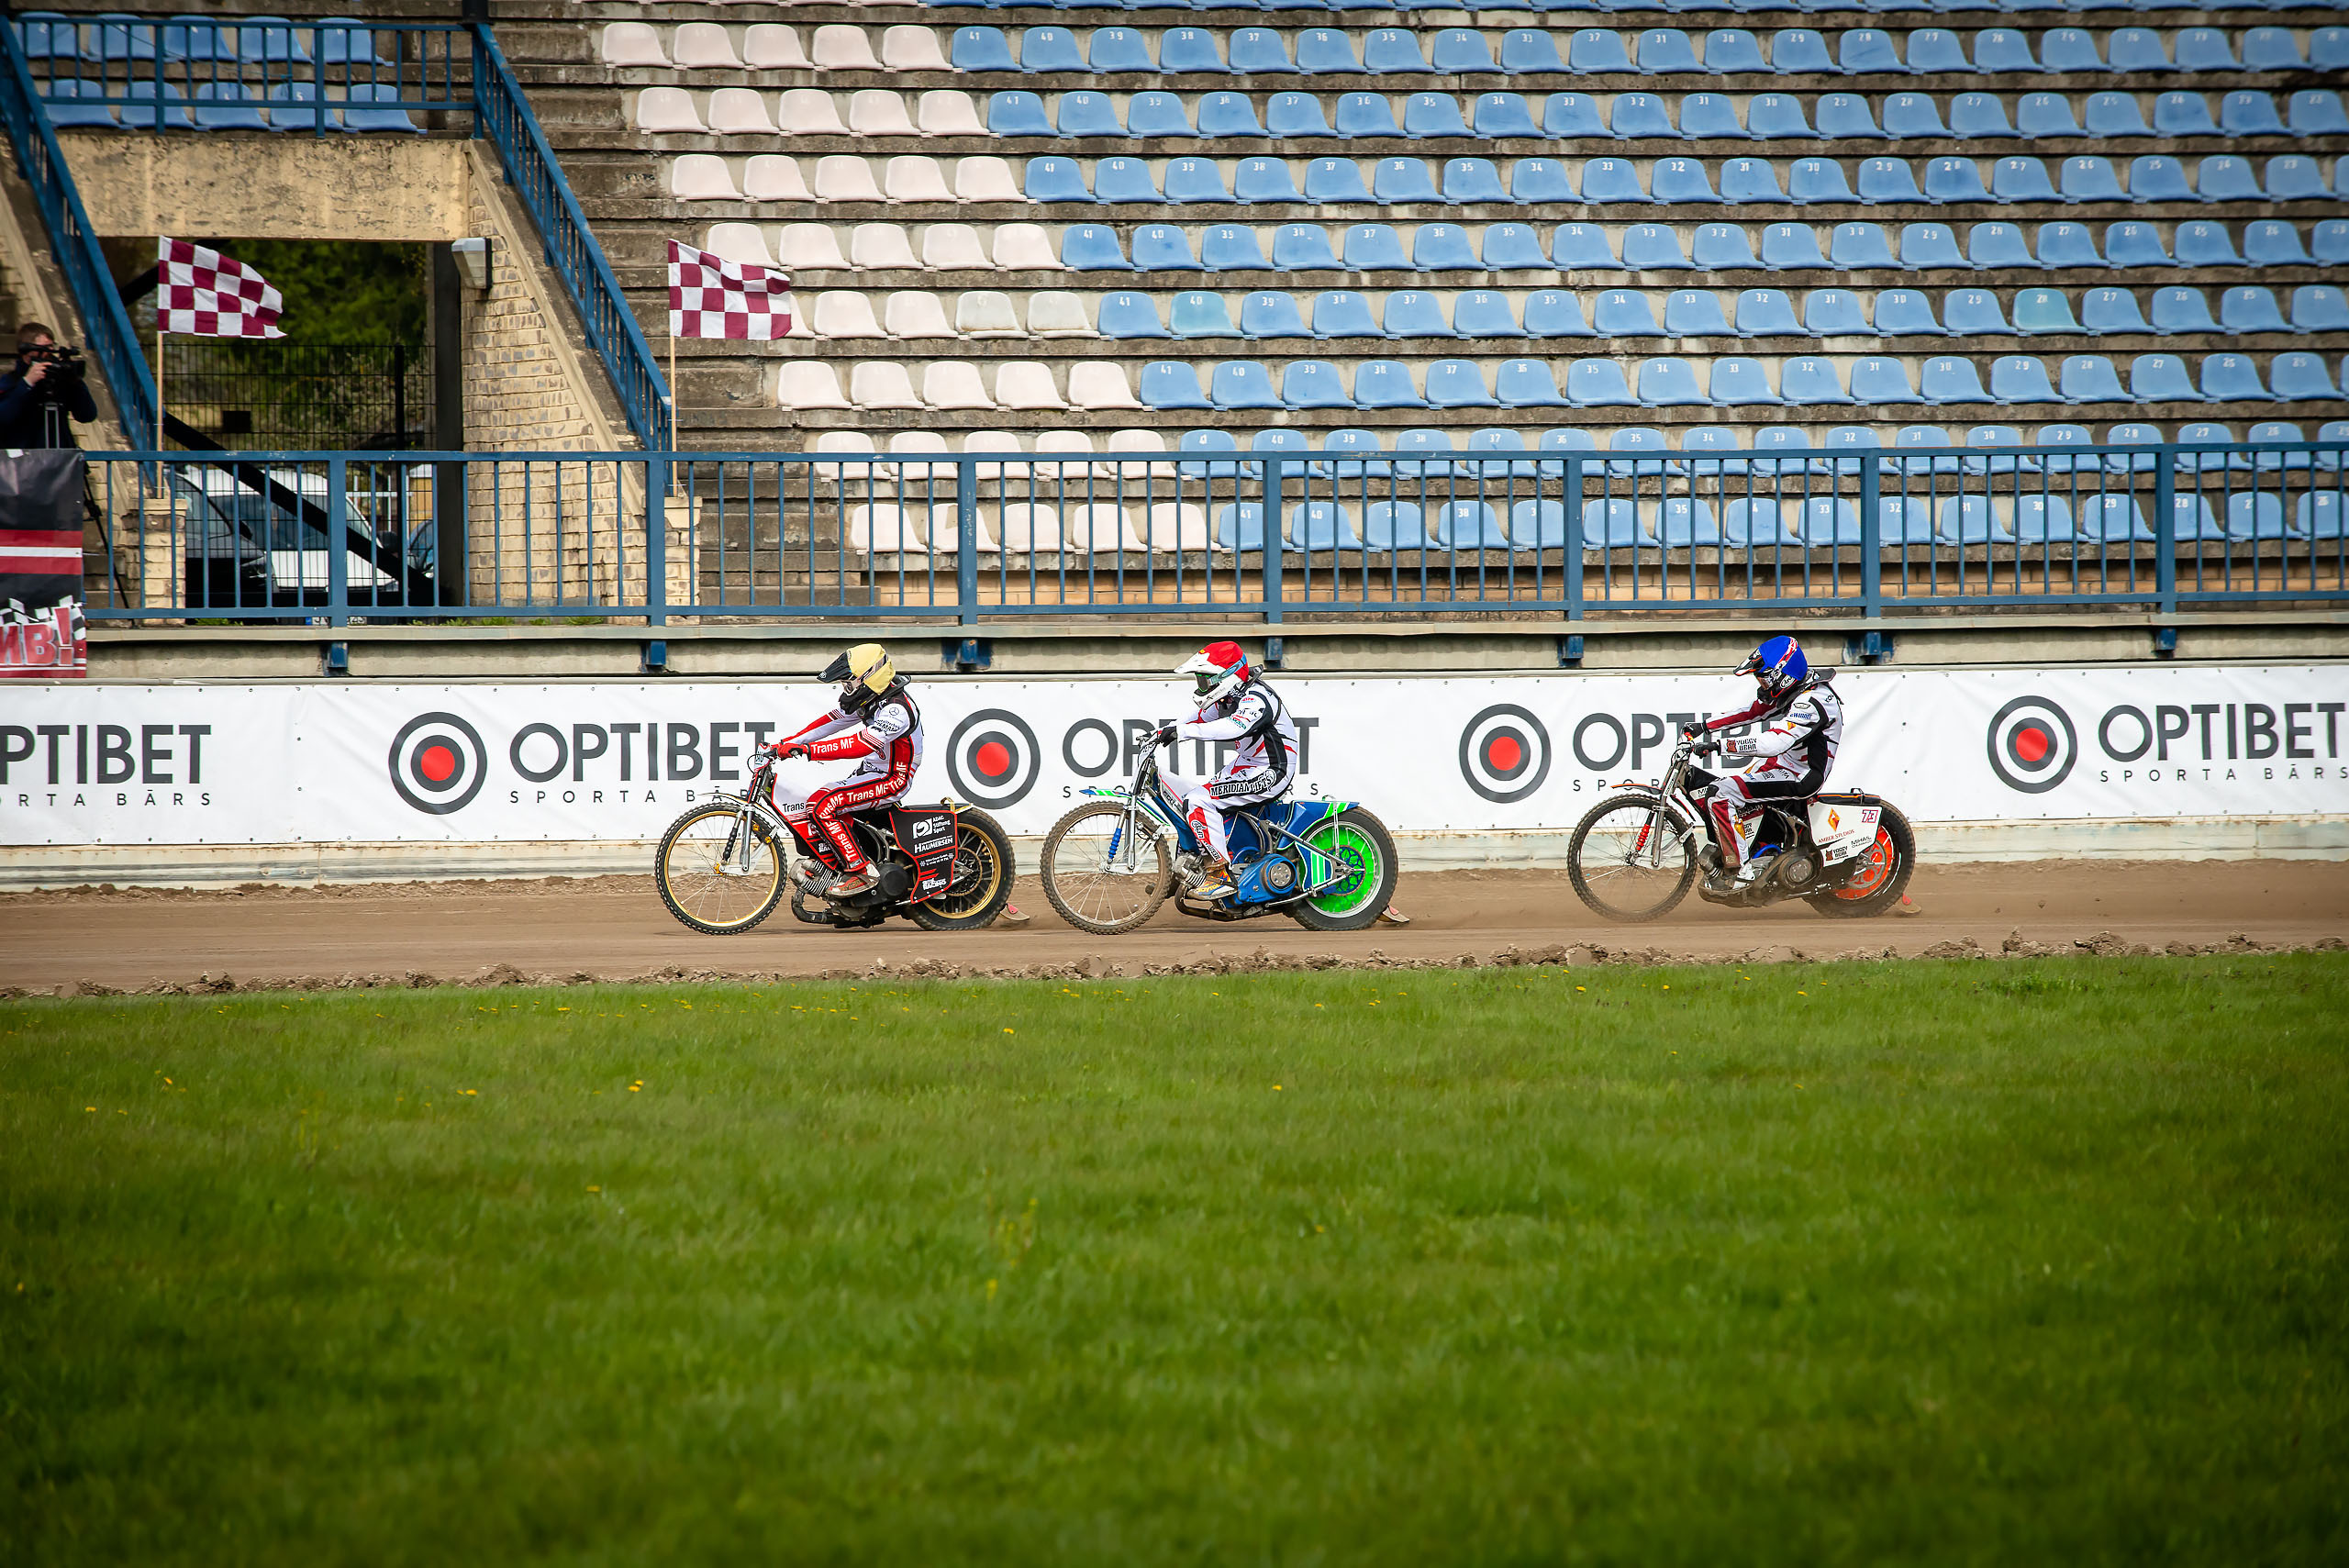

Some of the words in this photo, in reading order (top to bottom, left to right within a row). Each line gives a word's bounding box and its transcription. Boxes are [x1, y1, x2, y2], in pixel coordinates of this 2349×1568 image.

[968, 30, 981, 41] 41
[1040, 31, 1054, 42] 40
[1108, 30, 1124, 41] 39
[1180, 30, 1195, 41] 38
[1247, 32, 1261, 42] 37
[1315, 31, 1329, 42] 36
[1381, 31, 1397, 42] 35
[1454, 32, 1468, 42] 34
[1521, 33, 1532, 43] 33
[1654, 33, 1667, 44] 31
[1721, 33, 1735, 44] 30
[1790, 32, 1805, 43] 29
[1006, 95, 1019, 106] 41
[1075, 95, 1090, 106] 40
[1286, 95, 1299, 106] 37
[1356, 95, 1372, 106] 36
[1424, 96, 1436, 106] 35
[1491, 95, 1506, 106] 34
[1563, 96, 1575, 106] 33
[1631, 95, 1644, 106] 32
[1698, 95, 1709, 106] 31
[1765, 96, 1778, 107] 30
[1044, 162, 1054, 172] 41
[1111, 160, 1126, 171] 40
[1181, 161, 1196, 172] 39
[1253, 160, 1265, 171] 38
[1325, 160, 1336, 171] 37
[1394, 161, 1406, 171] 36
[1461, 161, 1474, 172] 35
[1531, 161, 1542, 172] 34
[1601, 161, 1616, 172] 33
[1671, 161, 1685, 172] 32
[1739, 161, 1751, 172] 31
[1807, 161, 1820, 172] 30
[1877, 161, 1892, 172] 29
[1943, 161, 1960, 171] 28
[2009, 161, 2026, 171] 27
[1083, 228, 1094, 239] 41
[1151, 228, 1164, 239] 40
[1292, 227, 1306, 238] 38
[1364, 228, 1375, 239] 37
[1432, 227, 1446, 238] 36
[1502, 226, 1516, 237] 35
[1570, 226, 1584, 236] 34
[1711, 227, 1728, 238] 32
[1780, 227, 1791, 238] 31
[1849, 226, 1864, 236] 30
[1923, 229, 1937, 239] 29
[2057, 225, 2071, 236] 27
[1119, 296, 1130, 306] 41
[1190, 295, 1203, 306] 40
[1263, 296, 1275, 306] 39
[1333, 295, 1346, 305] 38
[1404, 295, 1417, 305] 37
[1475, 294, 1488, 305] 36
[1544, 294, 1556, 305] 35
[1612, 294, 1627, 305] 34
[1684, 294, 1697, 305] 33
[1756, 293, 1768, 303] 32
[1824, 294, 1836, 305] 31
[1893, 294, 1908, 305] 30
[1968, 295, 1982, 305] 29
[2102, 291, 2118, 302] 27
[1160, 364, 1172, 375] 41
[1303, 363, 1317, 374] 39
[1374, 363, 1387, 374] 38
[1445, 364, 1458, 375] 37
[1586, 363, 1599, 374] 35
[1656, 363, 1669, 373] 34
[1729, 362, 1740, 373] 33
[1801, 361, 1813, 372] 32
[1868, 361, 1880, 372] 31
[1939, 361, 1953, 373] 30
[2015, 360, 2030, 371] 29
[2152, 359, 2164, 369] 27
[1232, 366, 1246, 377] 40
[1342, 433, 1356, 444] 39
[1489, 432, 1502, 443] 37
[1631, 431, 1642, 442] 35
[1702, 432, 1715, 443] 34
[1773, 431, 1786, 442] 33
[1844, 432, 1855, 442] 32
[1910, 430, 1922, 441] 31
[1983, 429, 1996, 440] 30
[2057, 430, 2072, 440] 29
[2124, 428, 2138, 438] 28
[1271, 434, 1285, 445] 40
[1889, 503, 1902, 513] 32
[2033, 501, 2044, 511] 30
[2104, 497, 2118, 508] 29
[2175, 497, 2189, 508] 28
[1241, 509, 1251, 519] 41
[1310, 509, 1325, 520] 40
[1459, 507, 1470, 517] 38
[1675, 504, 1689, 515] 35
[1819, 504, 1831, 514] 33
[2099, 703, 2346, 762] OPTIBET
[811, 743, 839, 754] Trans
[841, 738, 855, 750] MF
[510, 721, 775, 783] OPTIBET
[2100, 769, 2237, 783] SPORTA
[2265, 763, 2349, 780] BĀRS
[847, 790, 874, 803] Trans
[875, 784, 891, 796] MF
[1211, 781, 1250, 796] MERIDIAN
[0, 794, 86, 806] RTA
[117, 789, 211, 806] BĀRS
[509, 789, 657, 804] SPORTA
[782, 802, 805, 813] Trans
[1861, 809, 1879, 823] 73
[825, 821, 842, 835] MF
[837, 833, 857, 861] Trans
